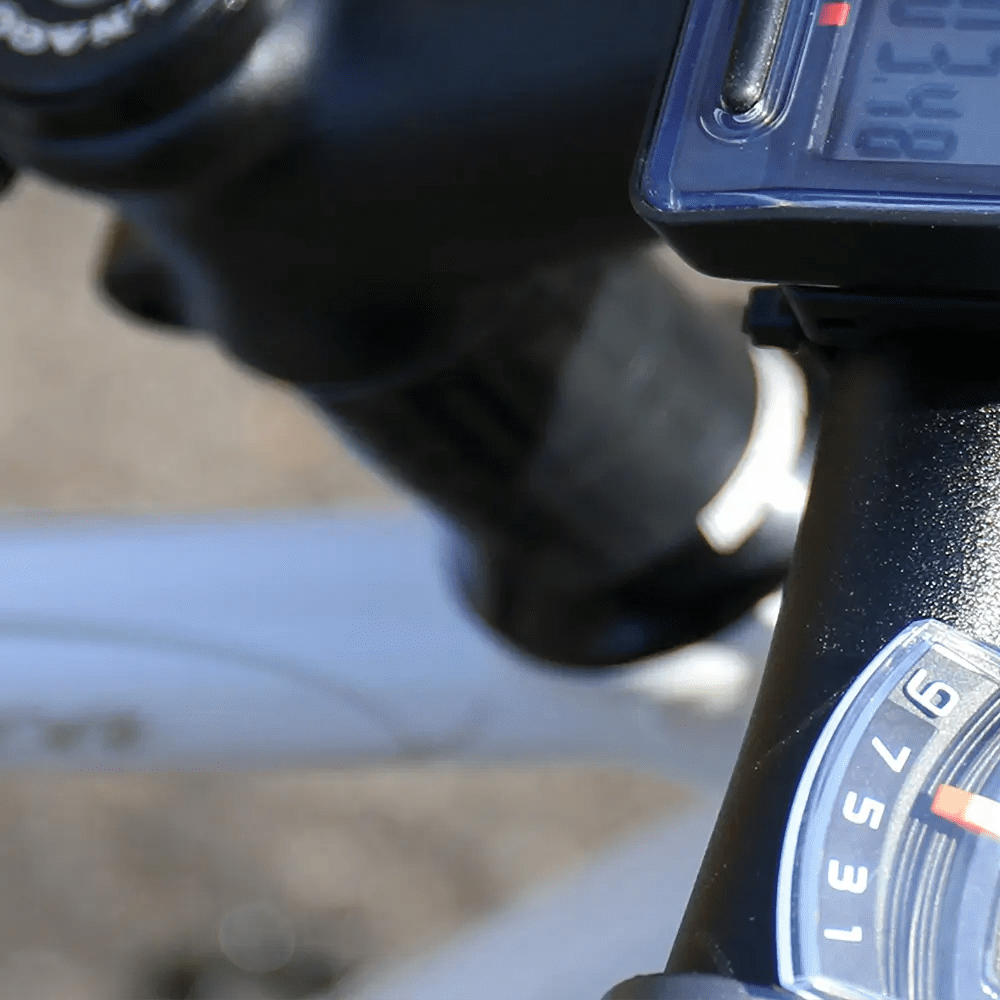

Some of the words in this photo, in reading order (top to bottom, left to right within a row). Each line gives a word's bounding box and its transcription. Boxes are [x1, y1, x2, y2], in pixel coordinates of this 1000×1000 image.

[904, 668, 961, 720] 9
[870, 736, 912, 772] 7
[842, 790, 886, 830] 5
[827, 859, 869, 894] 3
[823, 925, 863, 942] 1
